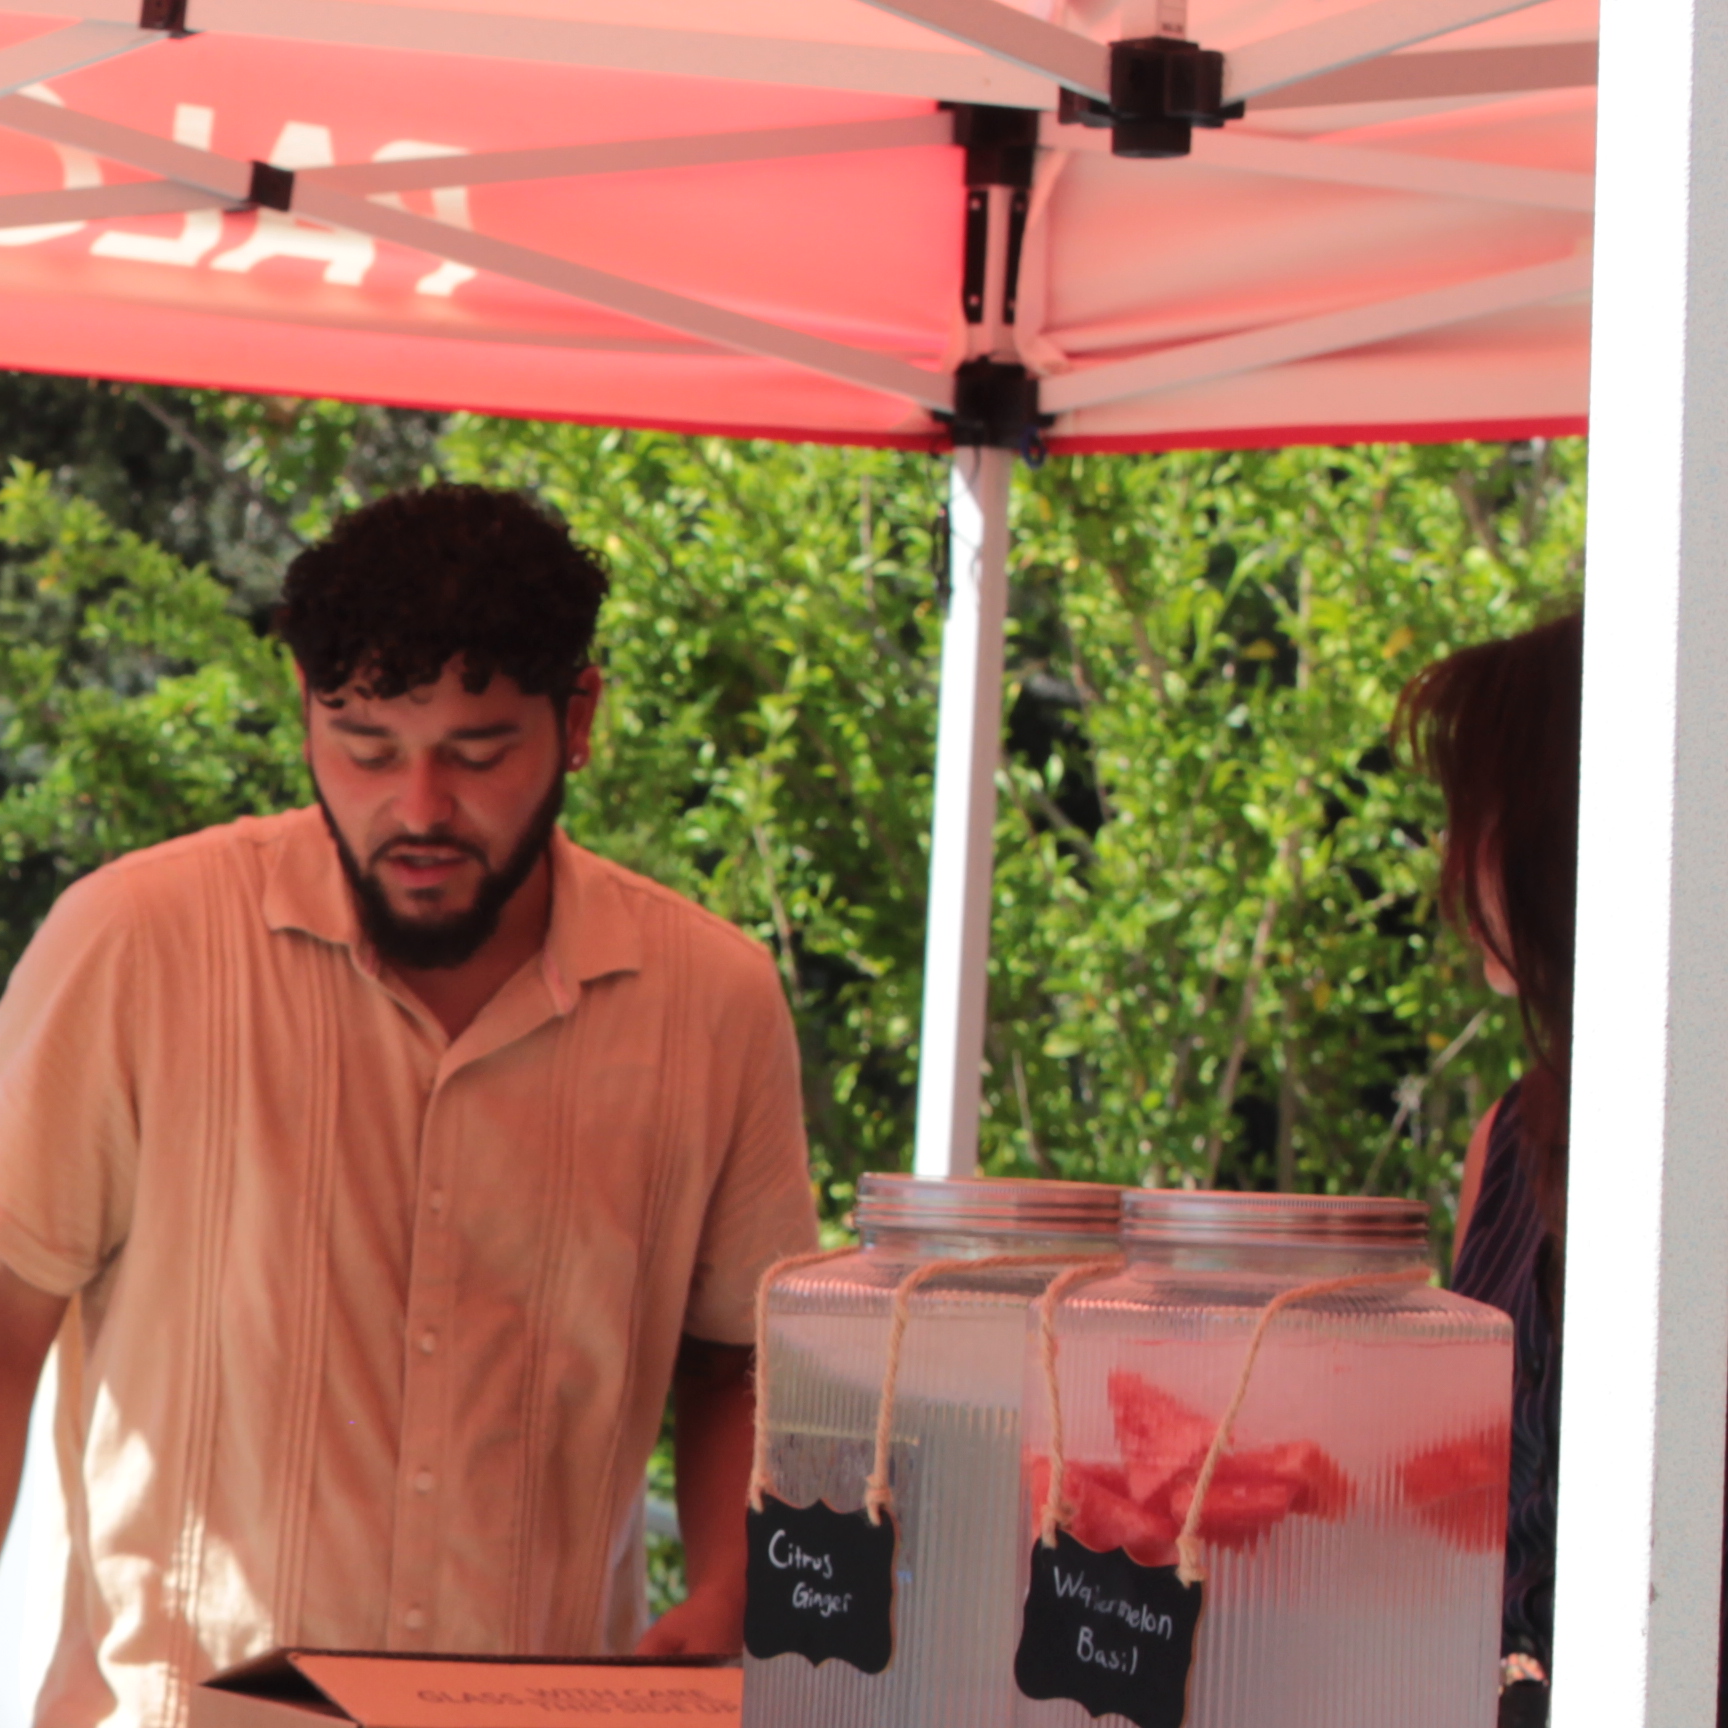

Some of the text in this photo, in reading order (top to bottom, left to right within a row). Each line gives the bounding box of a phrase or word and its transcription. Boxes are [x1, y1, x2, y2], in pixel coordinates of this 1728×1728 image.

[768, 1528, 833, 1579] Citrus
[792, 1582, 852, 1618] Ginger
[1077, 1626, 1138, 1675] Basil
